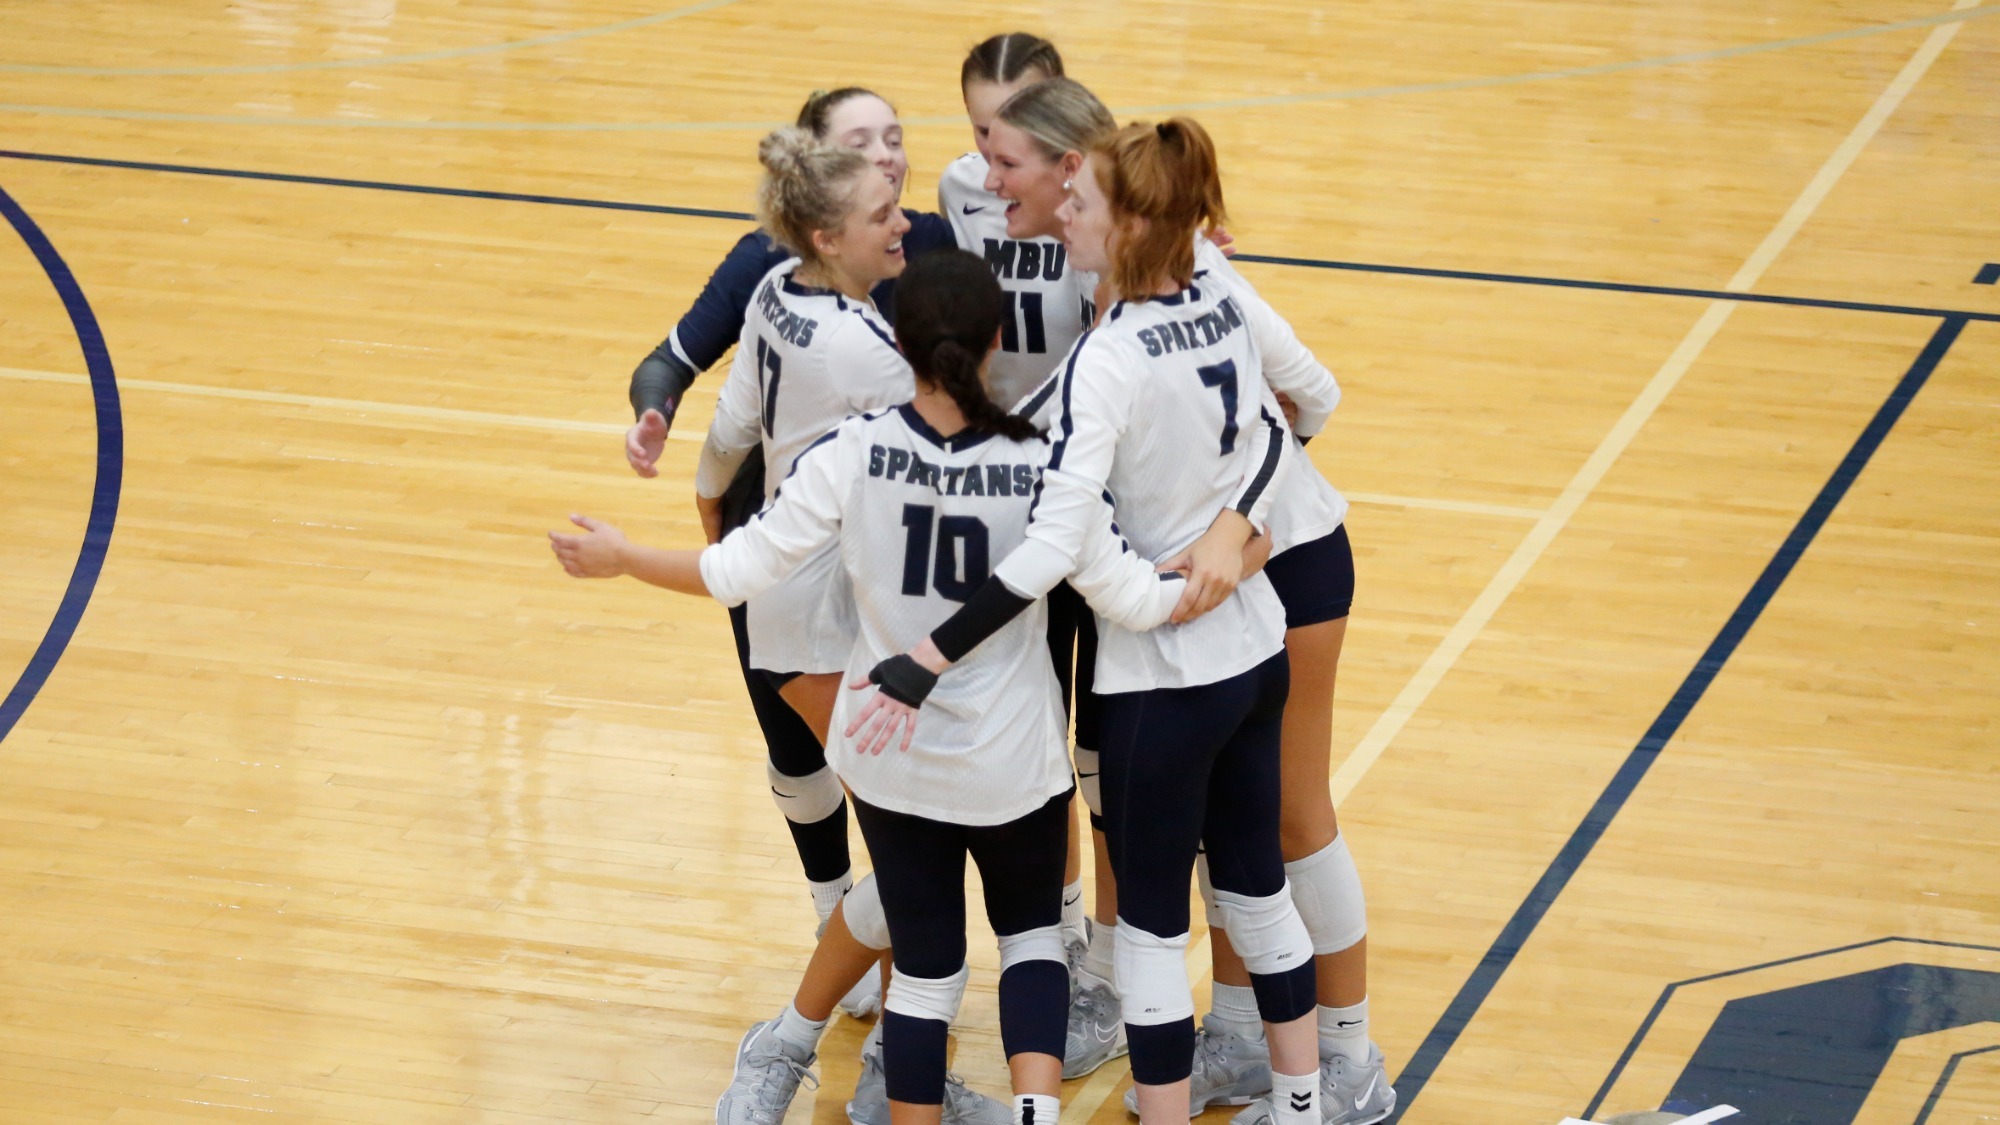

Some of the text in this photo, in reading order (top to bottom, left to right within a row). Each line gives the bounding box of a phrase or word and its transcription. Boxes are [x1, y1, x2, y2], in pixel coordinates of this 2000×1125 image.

[983, 237, 1067, 281] MBU
[1001, 290, 1047, 354] 11
[1136, 295, 1243, 358] SPARTAN
[757, 333, 782, 440] 17
[1196, 357, 1239, 457] 7
[868, 443, 1035, 497] SPARTANS
[902, 502, 989, 604] 10
